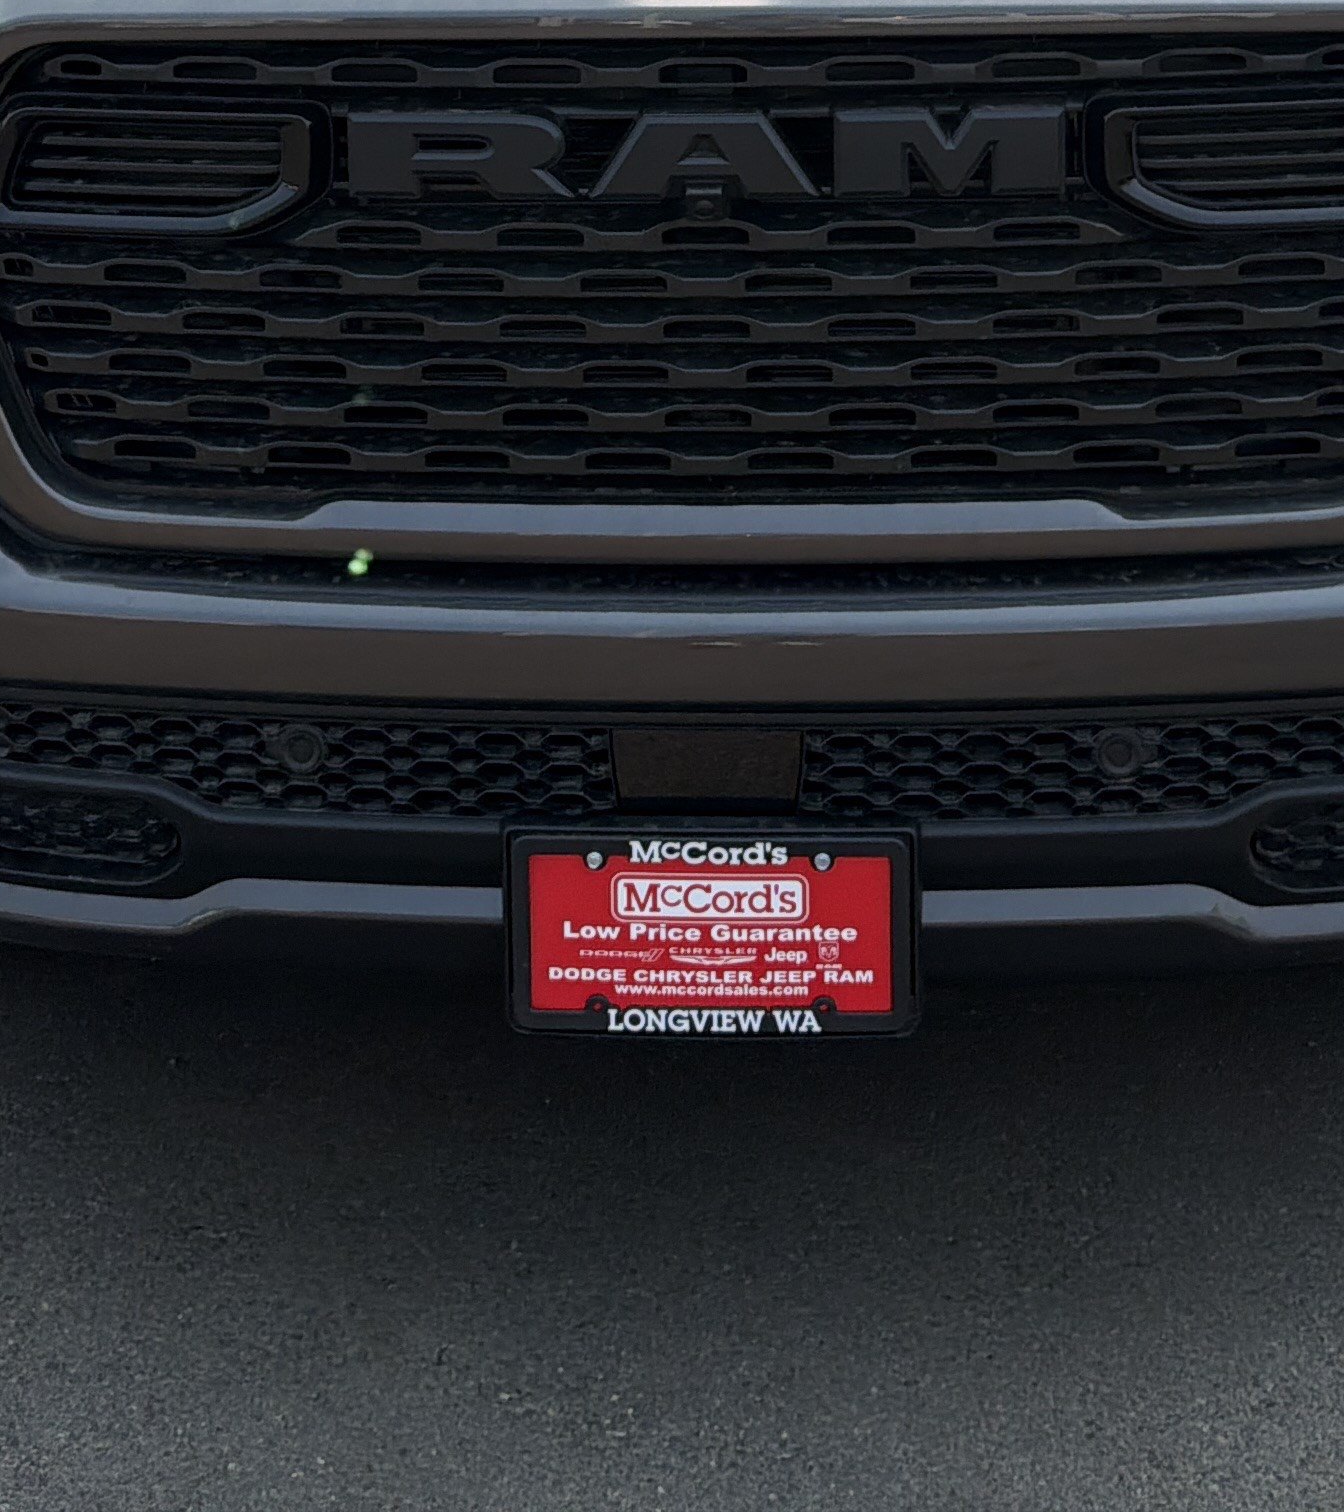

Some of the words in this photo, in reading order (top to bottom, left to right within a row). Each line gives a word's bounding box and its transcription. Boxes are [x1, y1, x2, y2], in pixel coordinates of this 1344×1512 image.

[346, 107, 1066, 197] RAM
[628, 840, 789, 866] McCord's
[623, 882, 797, 914] McCord's
[563, 920, 621, 939] Low
[629, 923, 702, 941] Price
[710, 923, 858, 942] Guarantee
[669, 946, 758, 956] CHRYSLER
[764, 947, 808, 965] Jeep
[548, 966, 627, 982] DODGE
[633, 969, 753, 984] CHRYSLER
[759, 970, 817, 984] JEEP
[823, 969, 874, 984] RAM
[614, 983, 810, 997] www.mccordsales.com
[607, 1008, 766, 1034] LONGVIEW
[772, 1009, 823, 1034] WA
